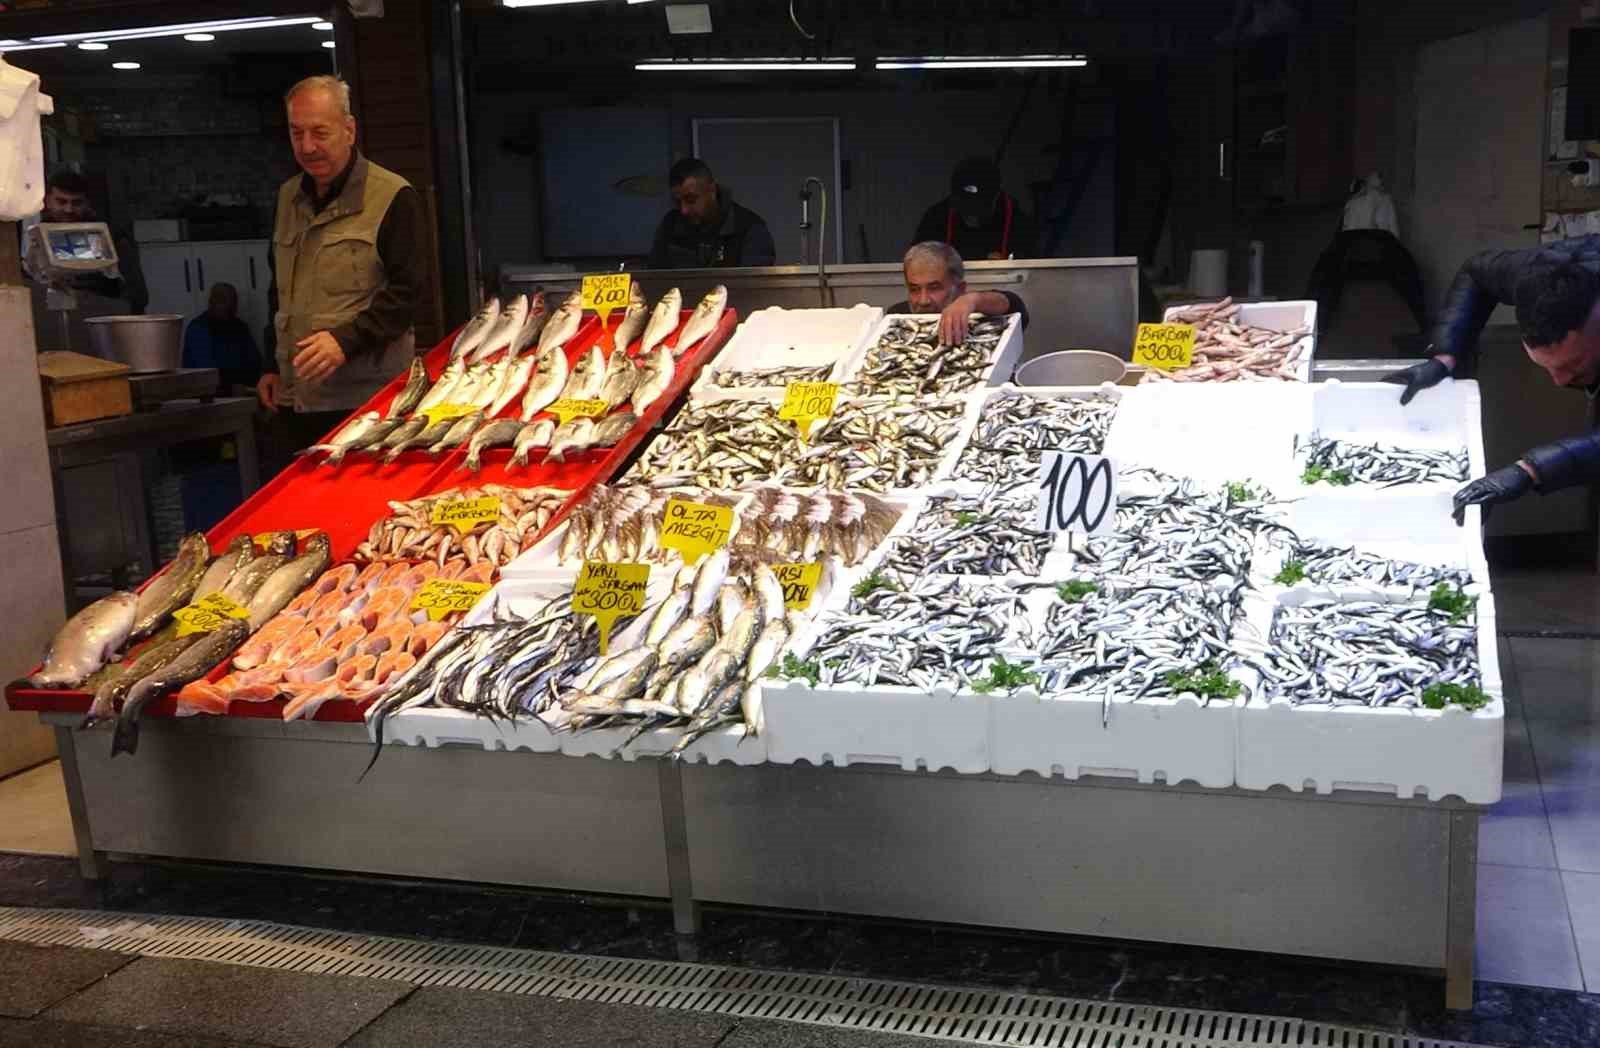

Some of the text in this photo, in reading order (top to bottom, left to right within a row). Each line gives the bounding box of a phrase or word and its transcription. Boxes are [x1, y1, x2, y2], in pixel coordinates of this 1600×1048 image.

[1139, 326, 1192, 342] BARBON
[799, 396, 833, 417] 100
[1040, 453, 1113, 533] 100
[671, 504, 717, 521] OLTA
